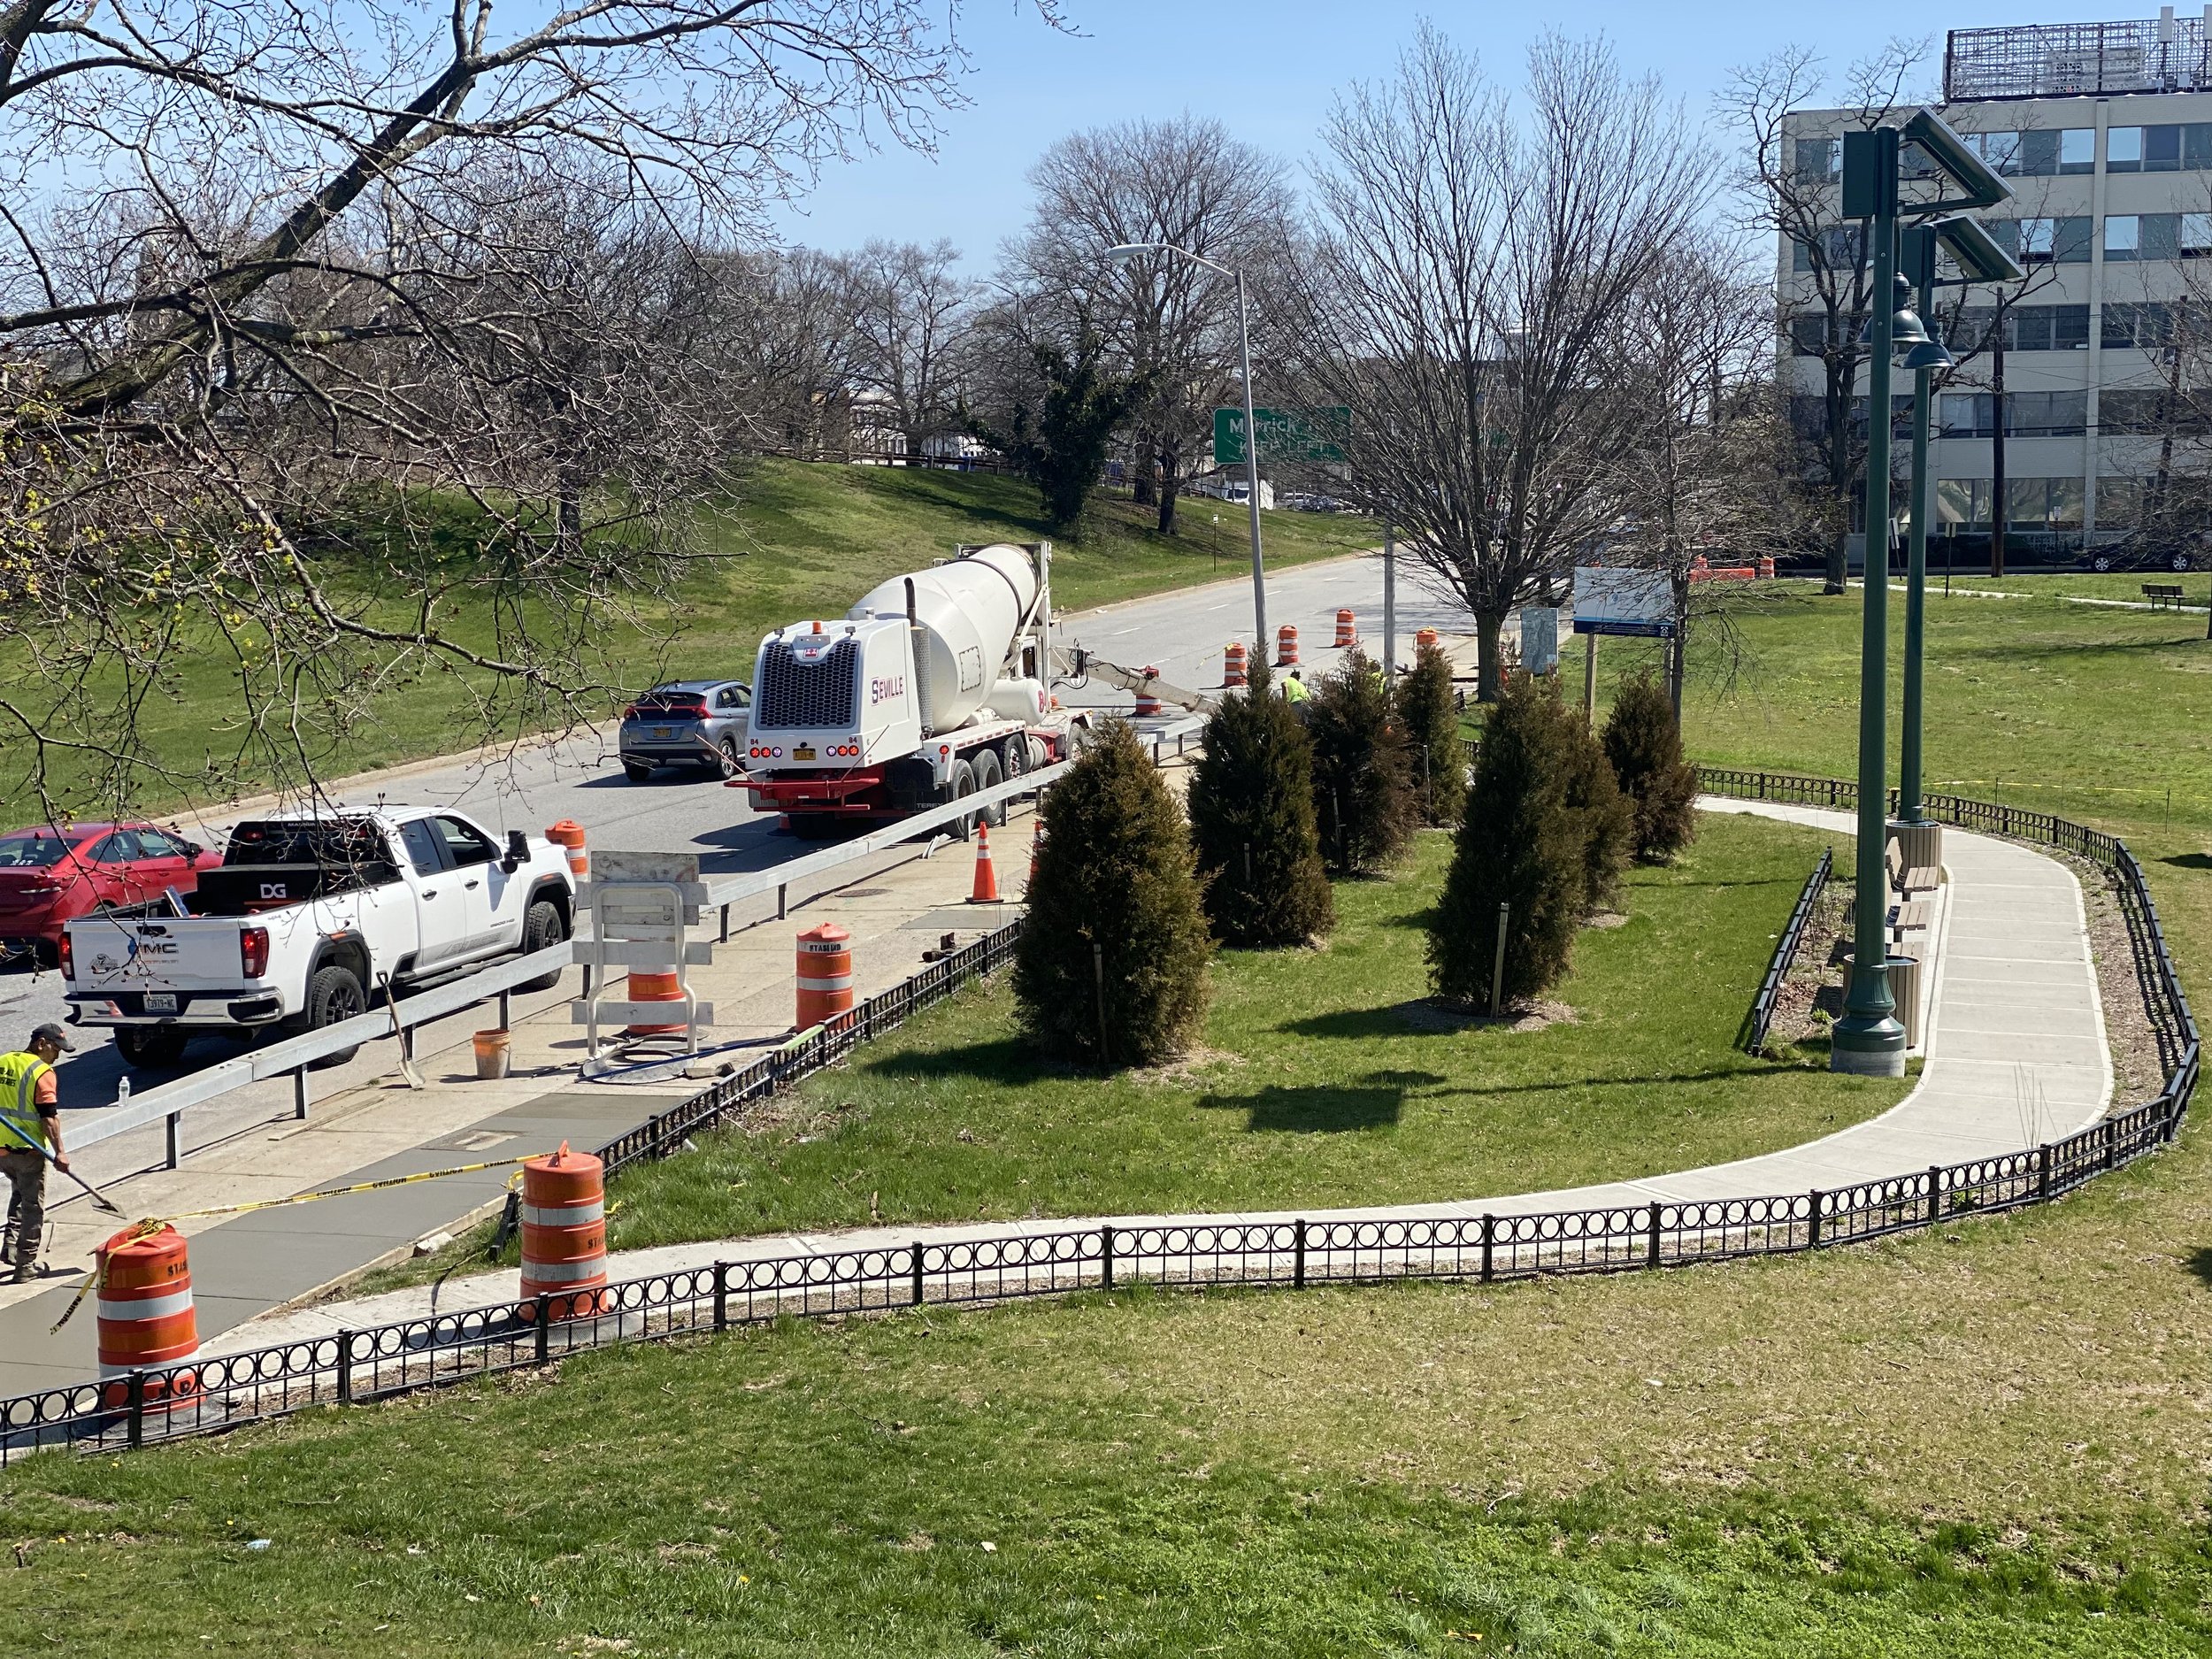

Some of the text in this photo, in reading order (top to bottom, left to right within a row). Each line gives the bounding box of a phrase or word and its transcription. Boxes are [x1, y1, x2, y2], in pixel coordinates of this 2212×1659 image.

[1229, 417, 1297, 433] Mrrick
[1240, 439, 1324, 453] KEP LEFT
[872, 677, 903, 704] SEVILLE
[260, 884, 287, 899] DG
